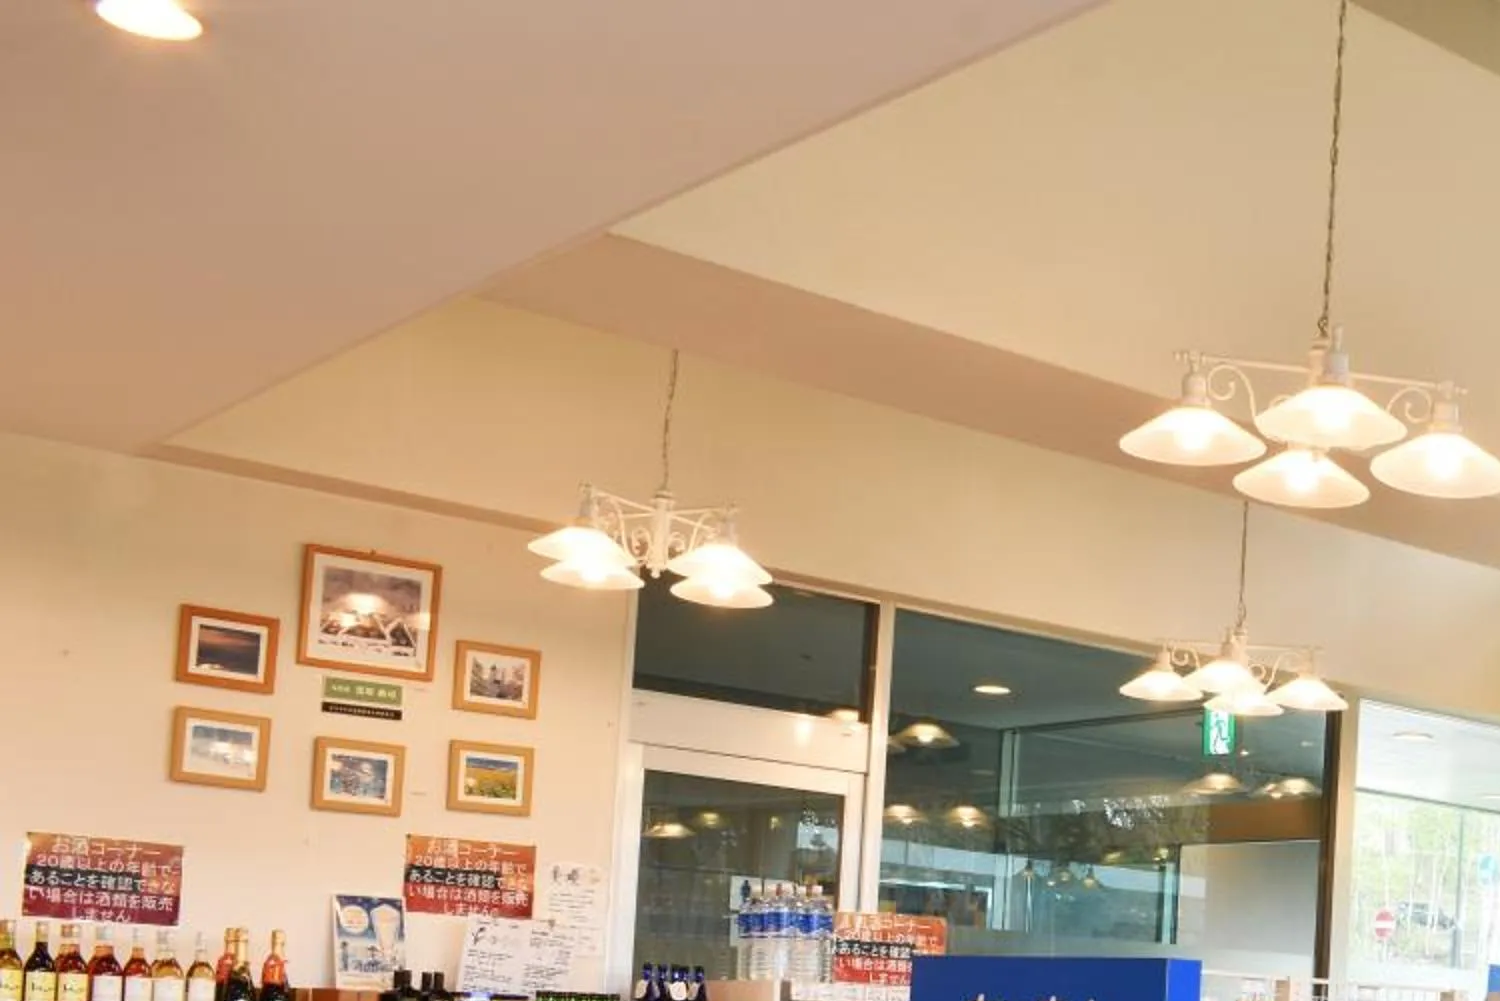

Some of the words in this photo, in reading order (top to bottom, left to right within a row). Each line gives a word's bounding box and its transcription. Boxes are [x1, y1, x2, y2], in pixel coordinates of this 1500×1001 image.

[52, 834, 161, 859] お酒コーナー
[427, 838, 520, 858] お酒コーナー
[36, 854, 172, 877] 20歳以上の年齢で
[415, 855, 528, 876] 20歳以上の年齢で
[29, 870, 175, 893] あることを確認できな
[409, 869, 529, 891] あることを確認できな
[28, 887, 173, 912] い場合は酒類を販売
[408, 885, 529, 906] い場合は酒類を販売
